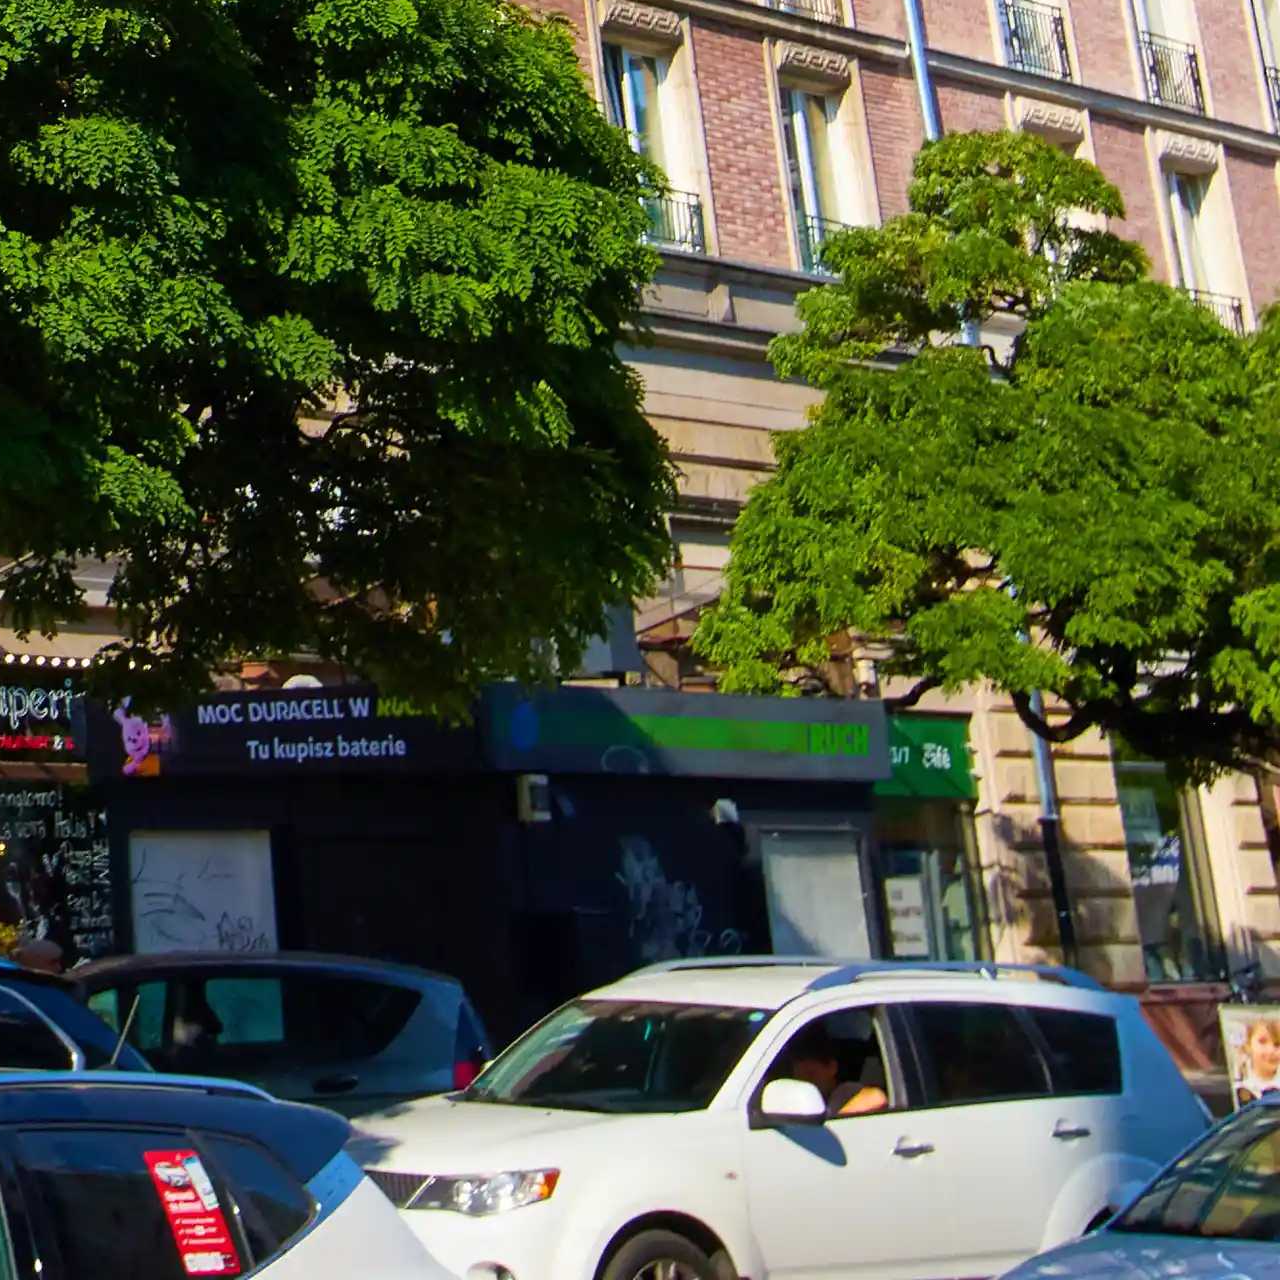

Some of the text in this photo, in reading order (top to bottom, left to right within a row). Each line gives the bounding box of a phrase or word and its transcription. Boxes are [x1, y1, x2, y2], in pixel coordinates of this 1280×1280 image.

[197, 703, 244, 725] MOC
[247, 698, 345, 723] DURACELL
[348, 696, 371, 718] W
[247, 734, 407, 763] Tu kupisz baterie
[809, 722, 870, 757] RUCH
